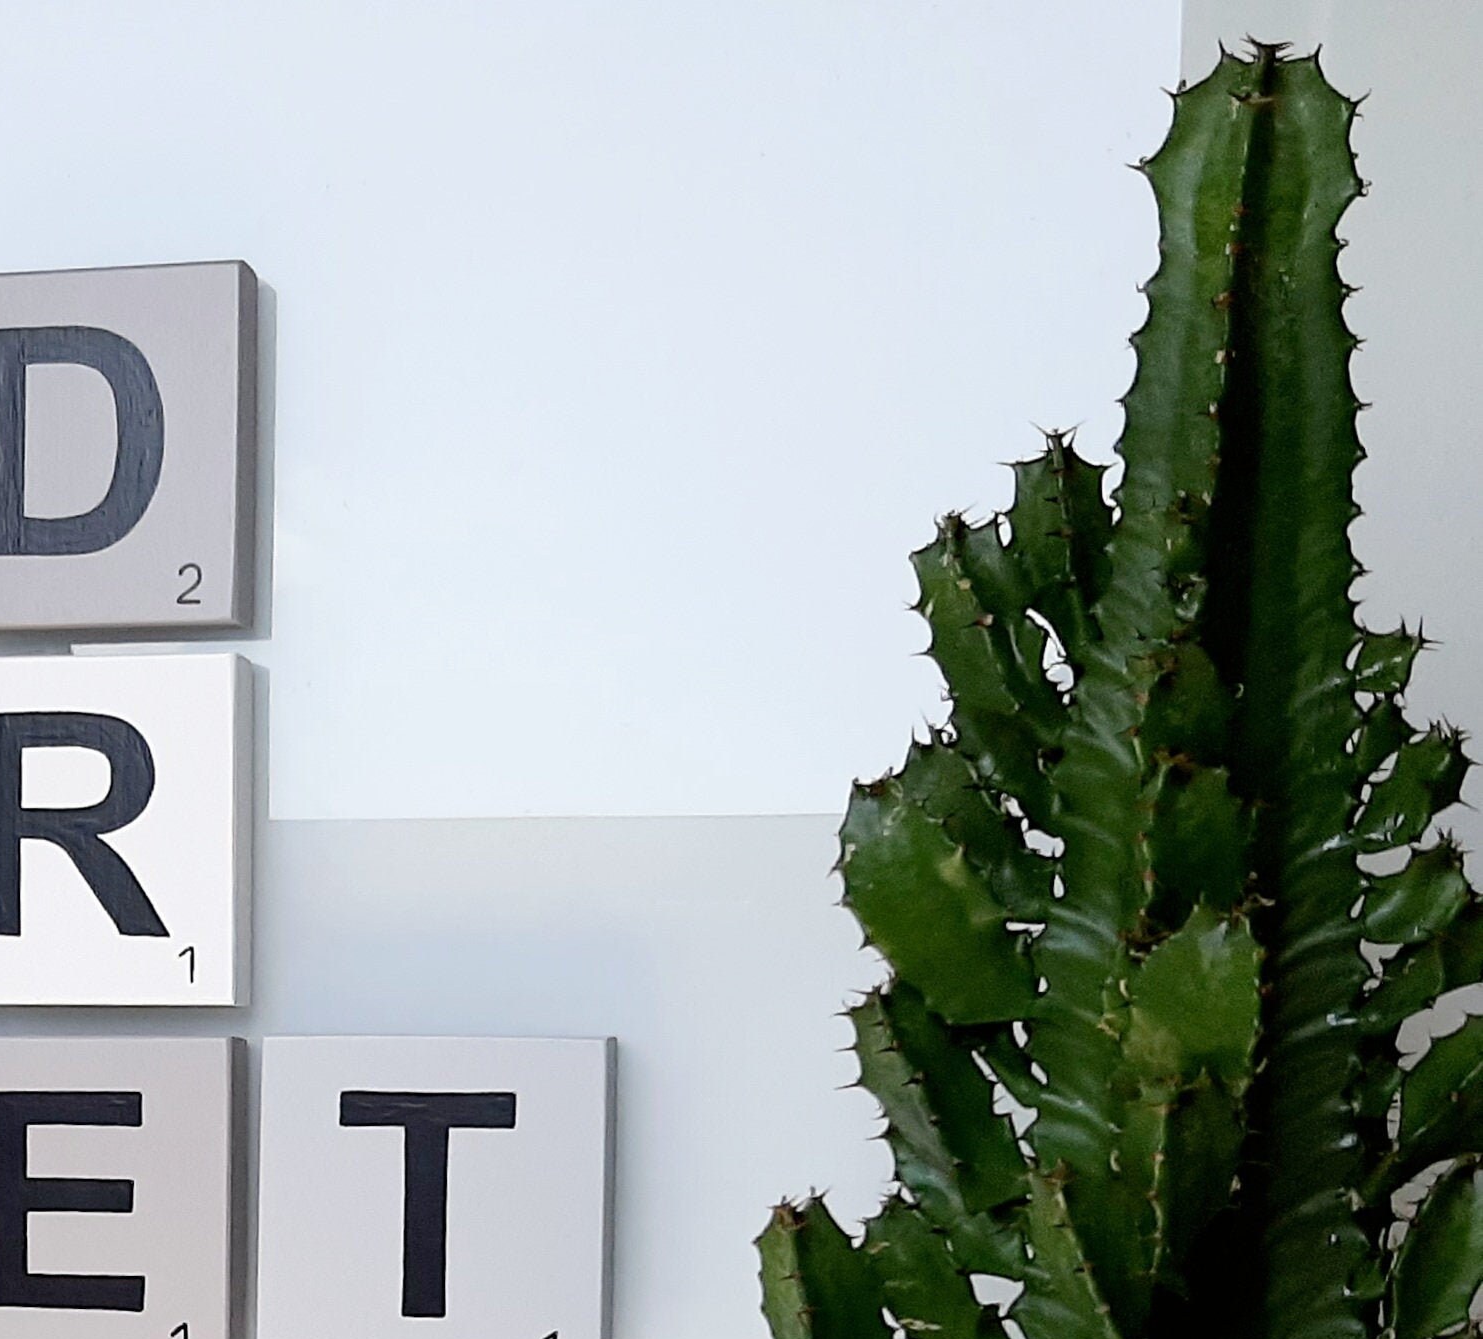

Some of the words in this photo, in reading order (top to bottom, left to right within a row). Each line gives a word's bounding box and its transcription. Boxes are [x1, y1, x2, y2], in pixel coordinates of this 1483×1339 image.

[176, 563, 202, 605] 2
[178, 946, 195, 984] 1
[340, 1091, 516, 1318] T
